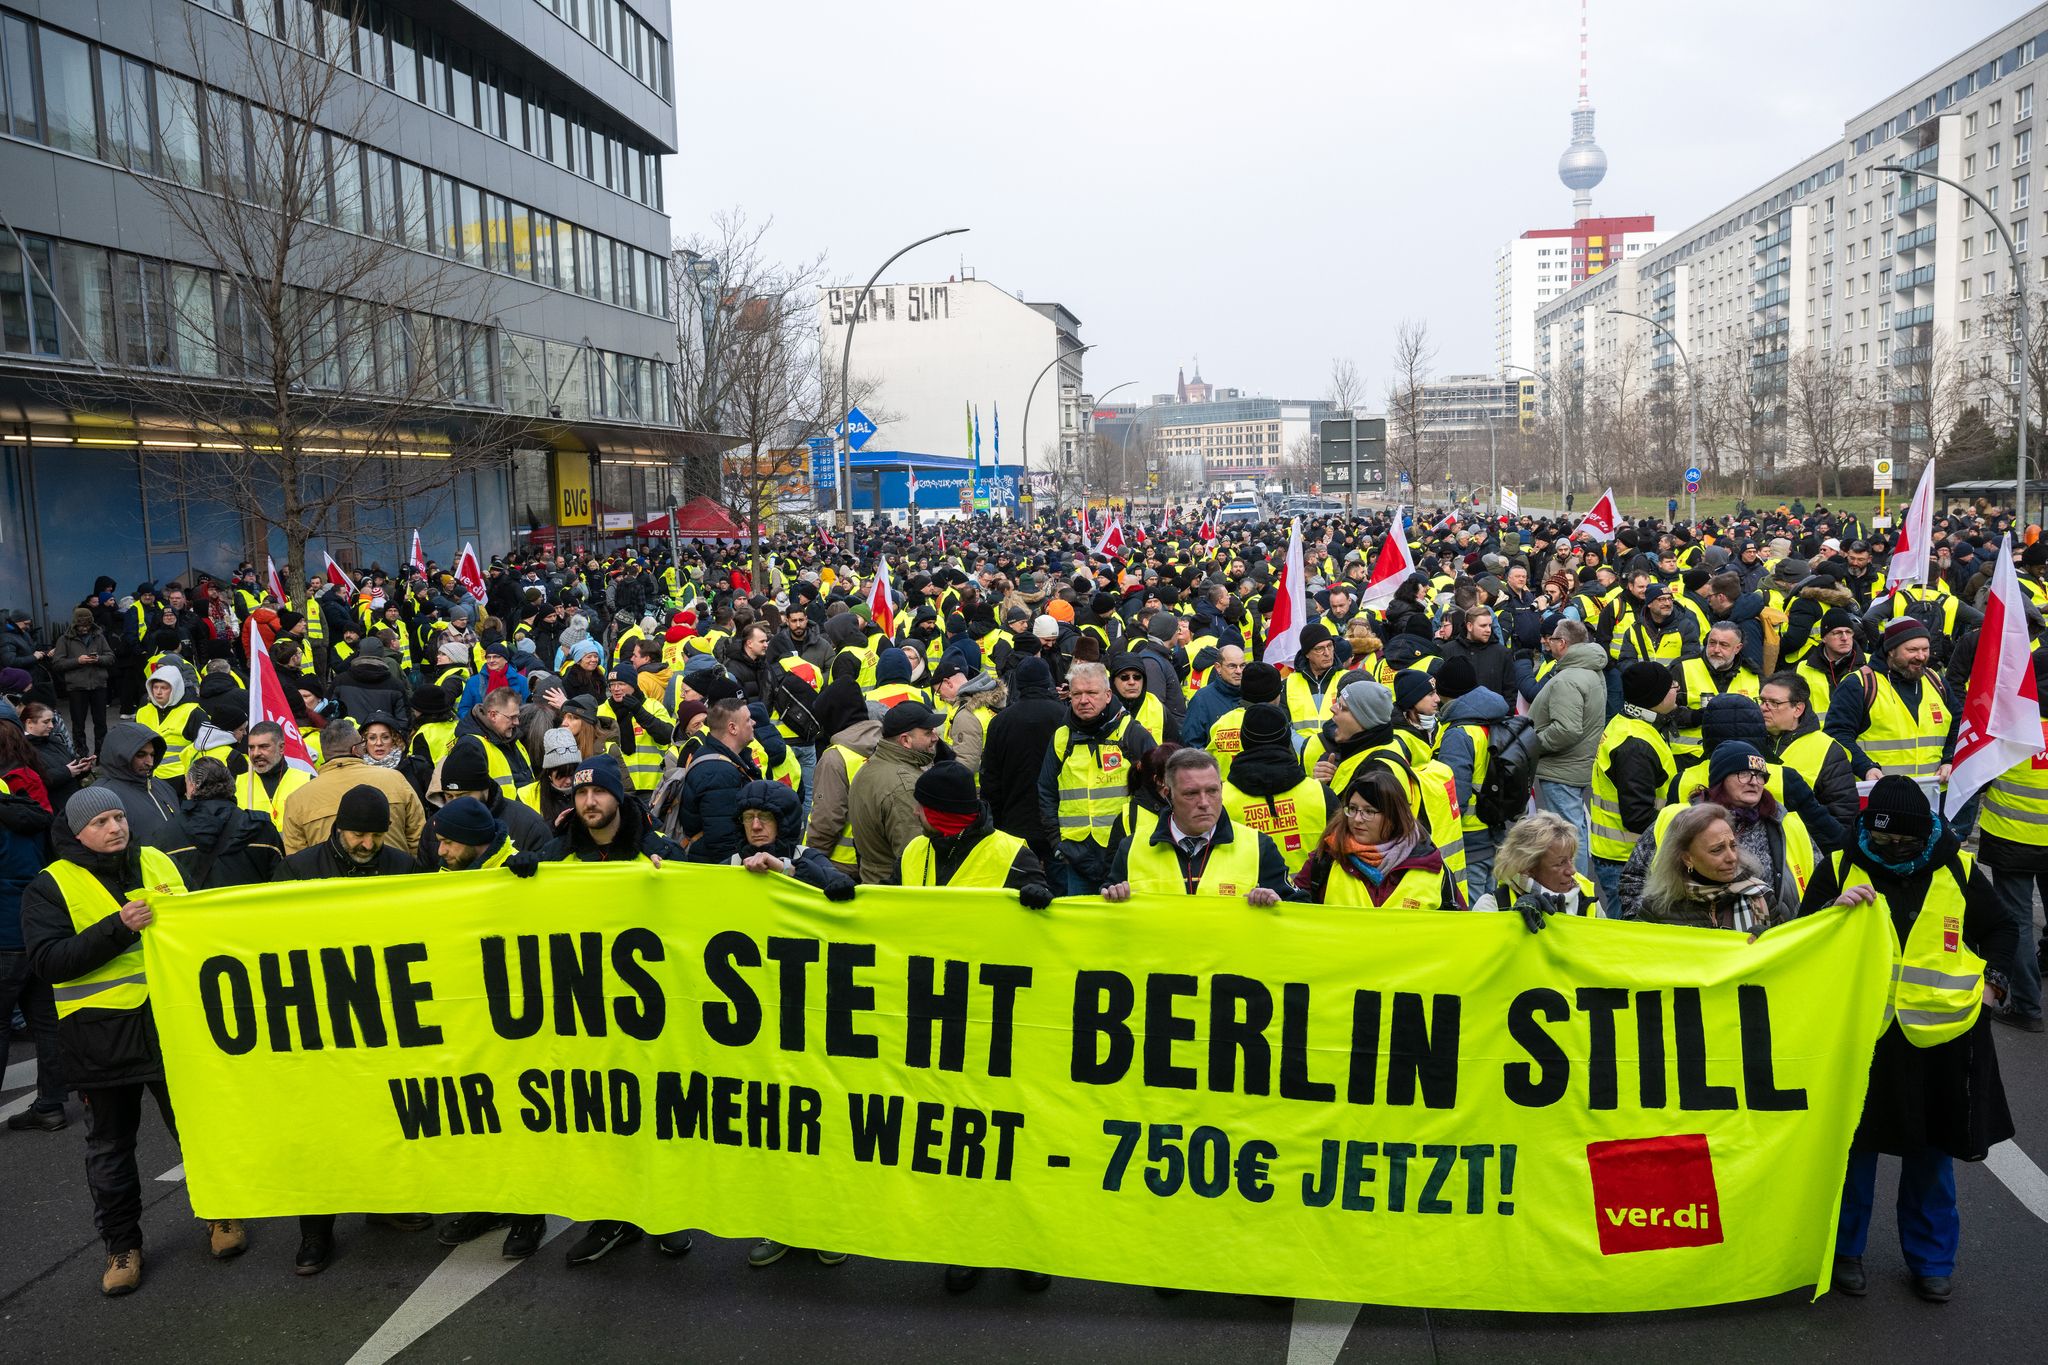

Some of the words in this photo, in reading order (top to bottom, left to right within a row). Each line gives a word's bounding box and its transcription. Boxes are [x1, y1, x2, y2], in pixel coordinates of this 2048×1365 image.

[563, 488, 588, 518] BVG
[1244, 802, 1296, 822] ZUSAMEN
[1272, 815, 1298, 830] MEHR
[200, 935, 444, 1055] OHNE
[481, 928, 665, 1040] UNS
[703, 931, 1032, 1077] STEHT
[1071, 970, 1461, 1109] BERLIN
[1504, 985, 1808, 1111] STILL
[389, 1077, 501, 1139] WIR
[518, 1069, 642, 1136] SIND
[656, 1071, 821, 1155] MEHR
[848, 1093, 1024, 1181] WERT
[1048, 1155, 1070, 1167] -
[1103, 1120, 1277, 1202] 750€
[1302, 1140, 1517, 1215] JETZT!
[1604, 1203, 1708, 1229] ver.di
